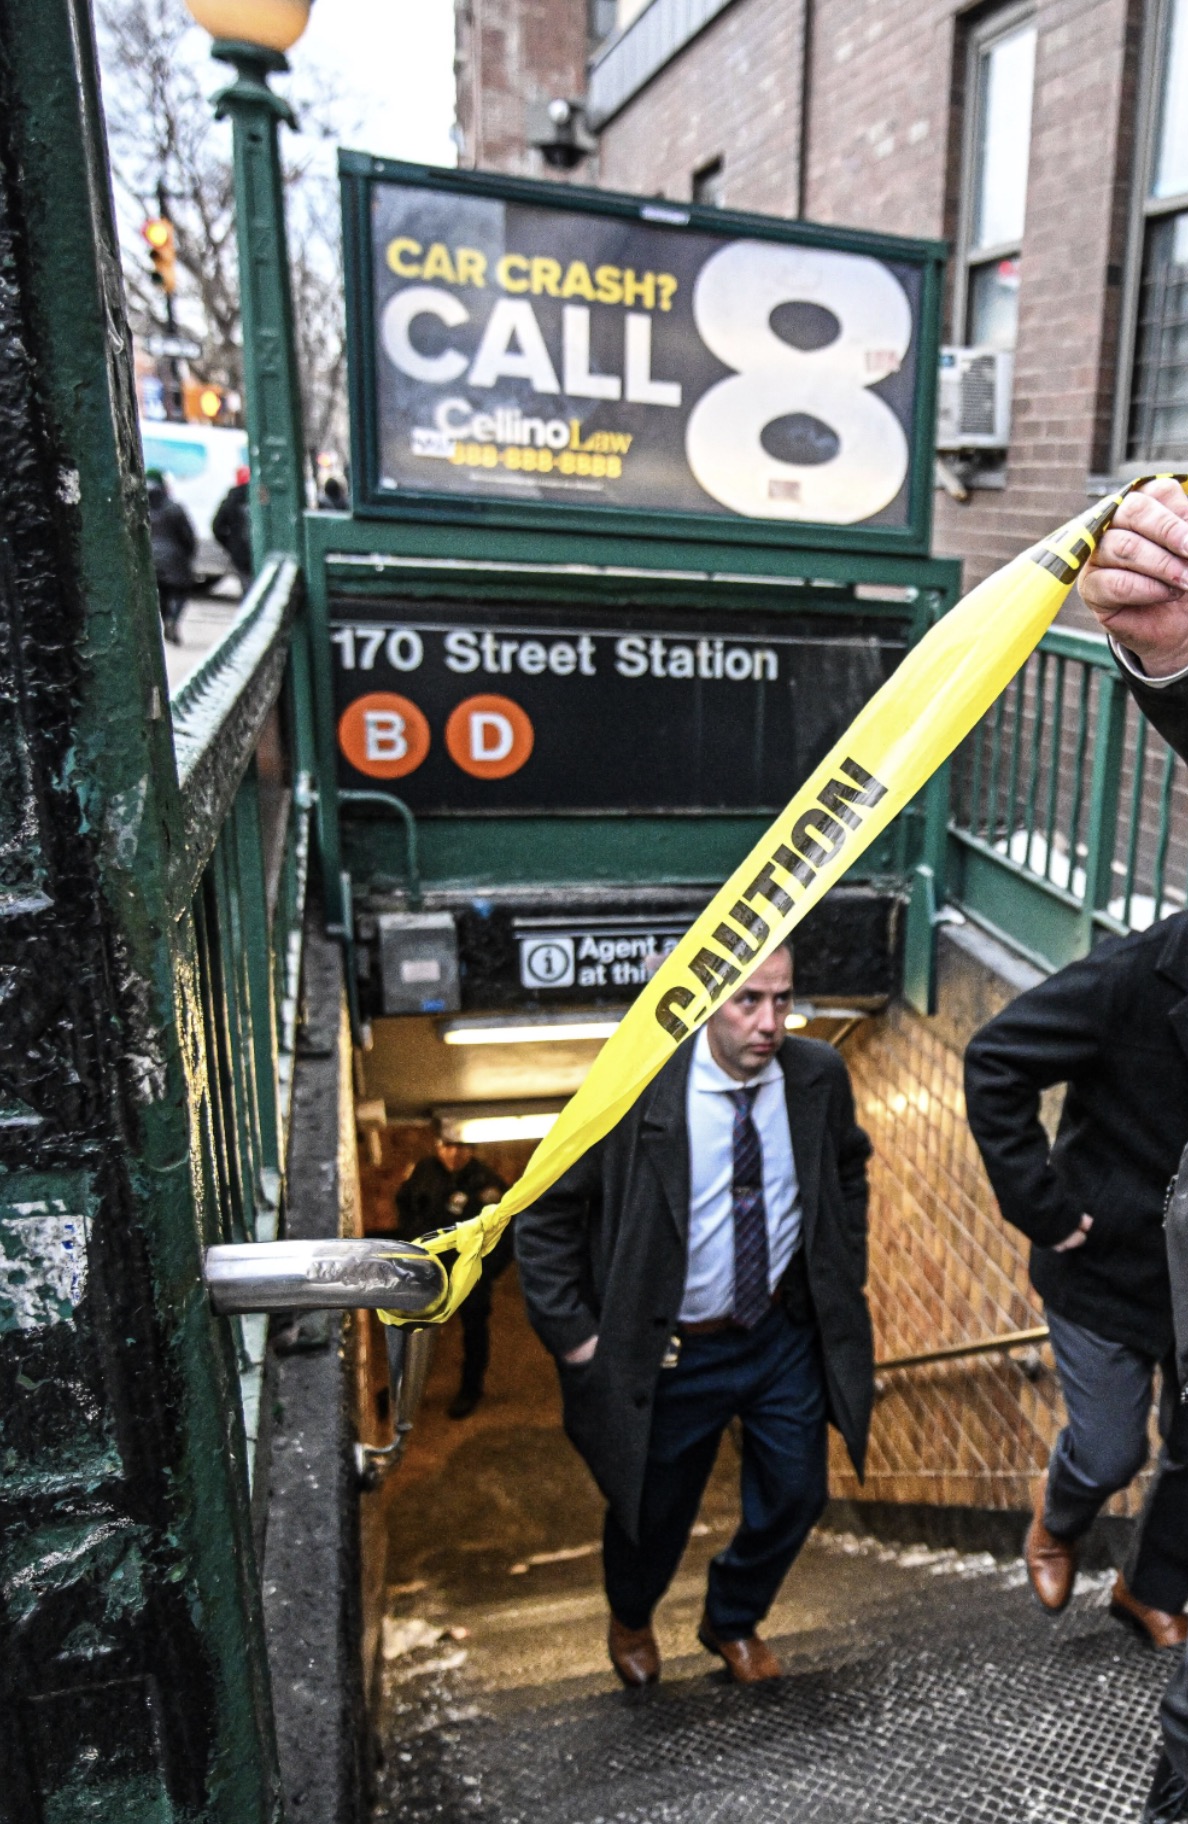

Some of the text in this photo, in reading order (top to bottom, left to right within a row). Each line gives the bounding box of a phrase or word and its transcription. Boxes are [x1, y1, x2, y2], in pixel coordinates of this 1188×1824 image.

[386, 237, 678, 312] CAR CRASH?
[382, 240, 912, 524] CALL 8
[332, 629, 778, 681] 170 Street Station
[363, 710, 514, 761] B D
[655, 756, 889, 1043] CAUTION
[578, 936, 657, 963] Agent
[578, 961, 652, 986] at thi
